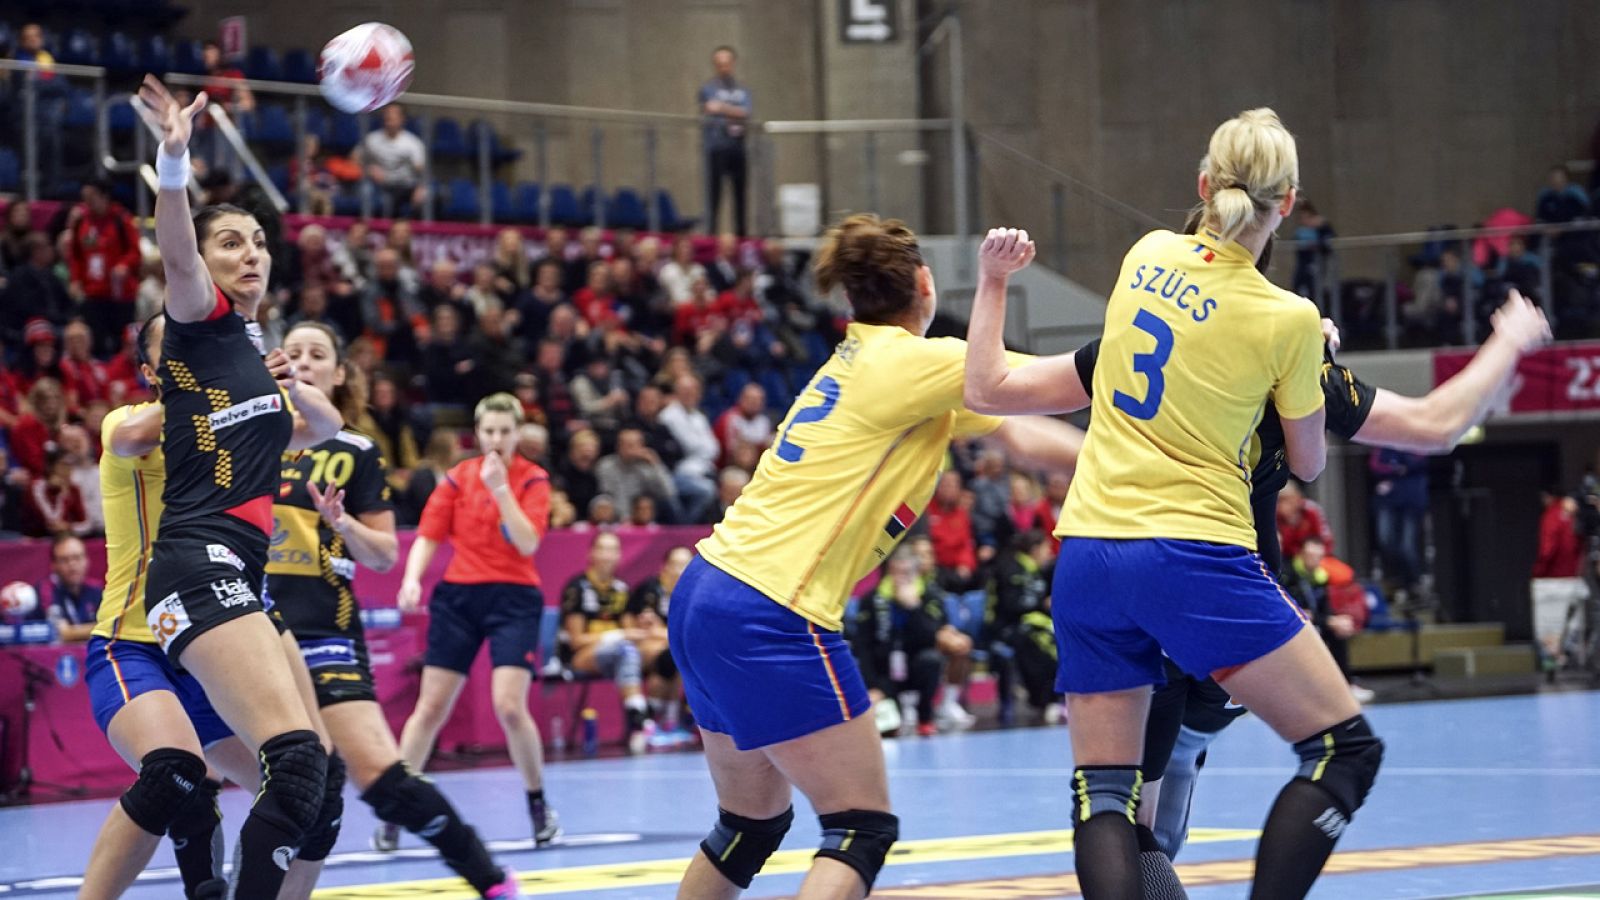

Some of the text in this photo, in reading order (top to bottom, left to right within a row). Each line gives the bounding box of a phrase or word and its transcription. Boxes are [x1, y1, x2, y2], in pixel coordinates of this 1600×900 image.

[1130, 264, 1217, 322] SZÜCS
[1113, 307, 1174, 421] 3
[310, 449, 355, 488] 10
